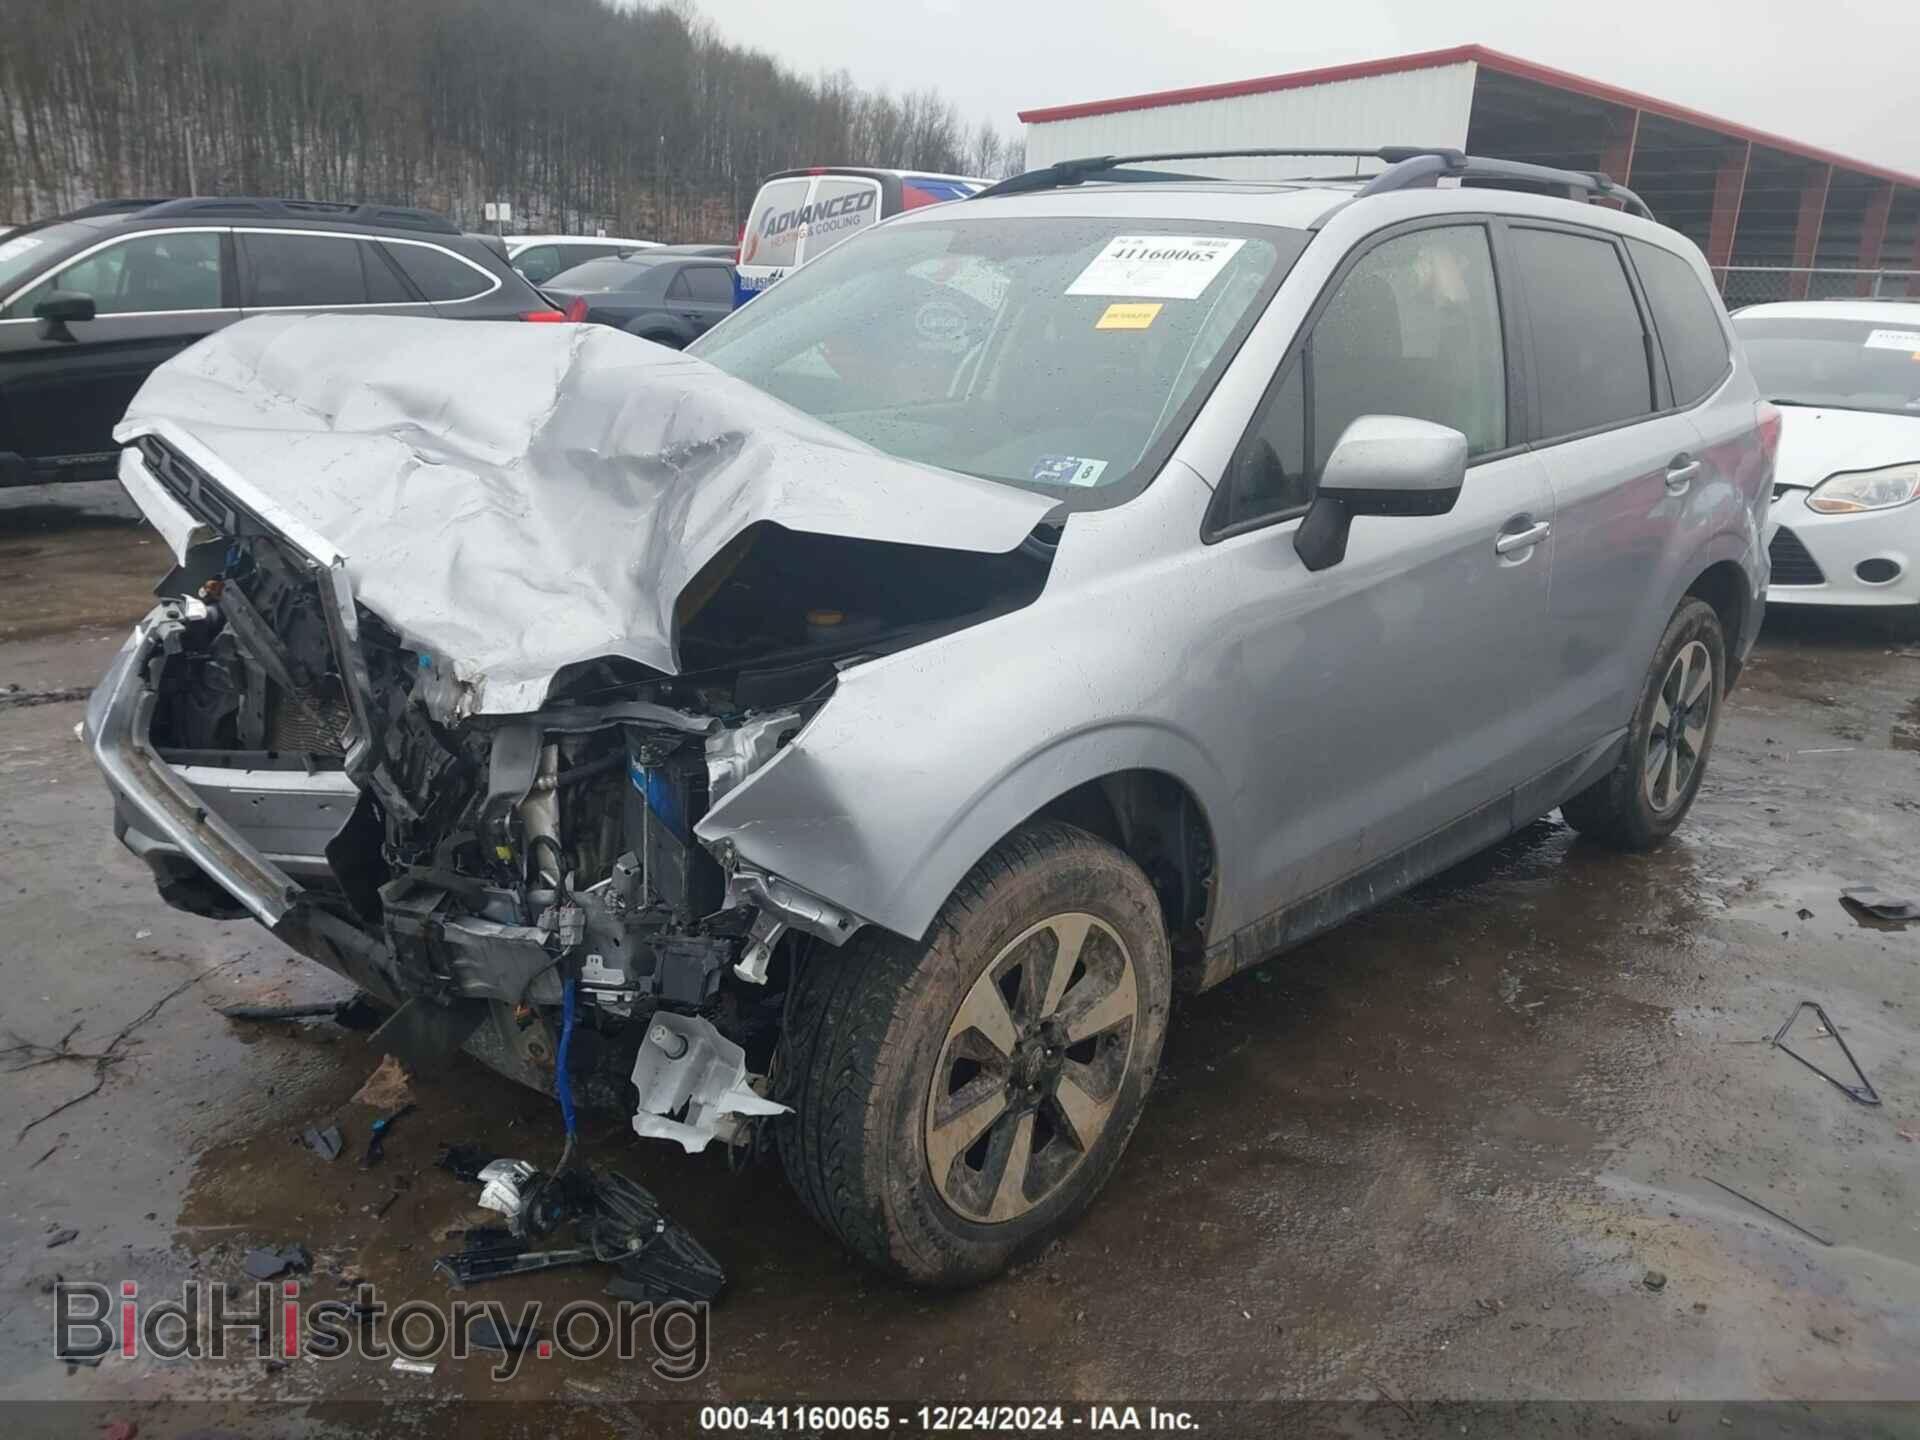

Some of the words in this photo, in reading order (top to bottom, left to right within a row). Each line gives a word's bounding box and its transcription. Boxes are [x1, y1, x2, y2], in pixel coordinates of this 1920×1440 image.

[763, 190, 876, 238] ADVANCED
[815, 215, 861, 234] COOLING
[1111, 249, 1219, 263] 41160065
